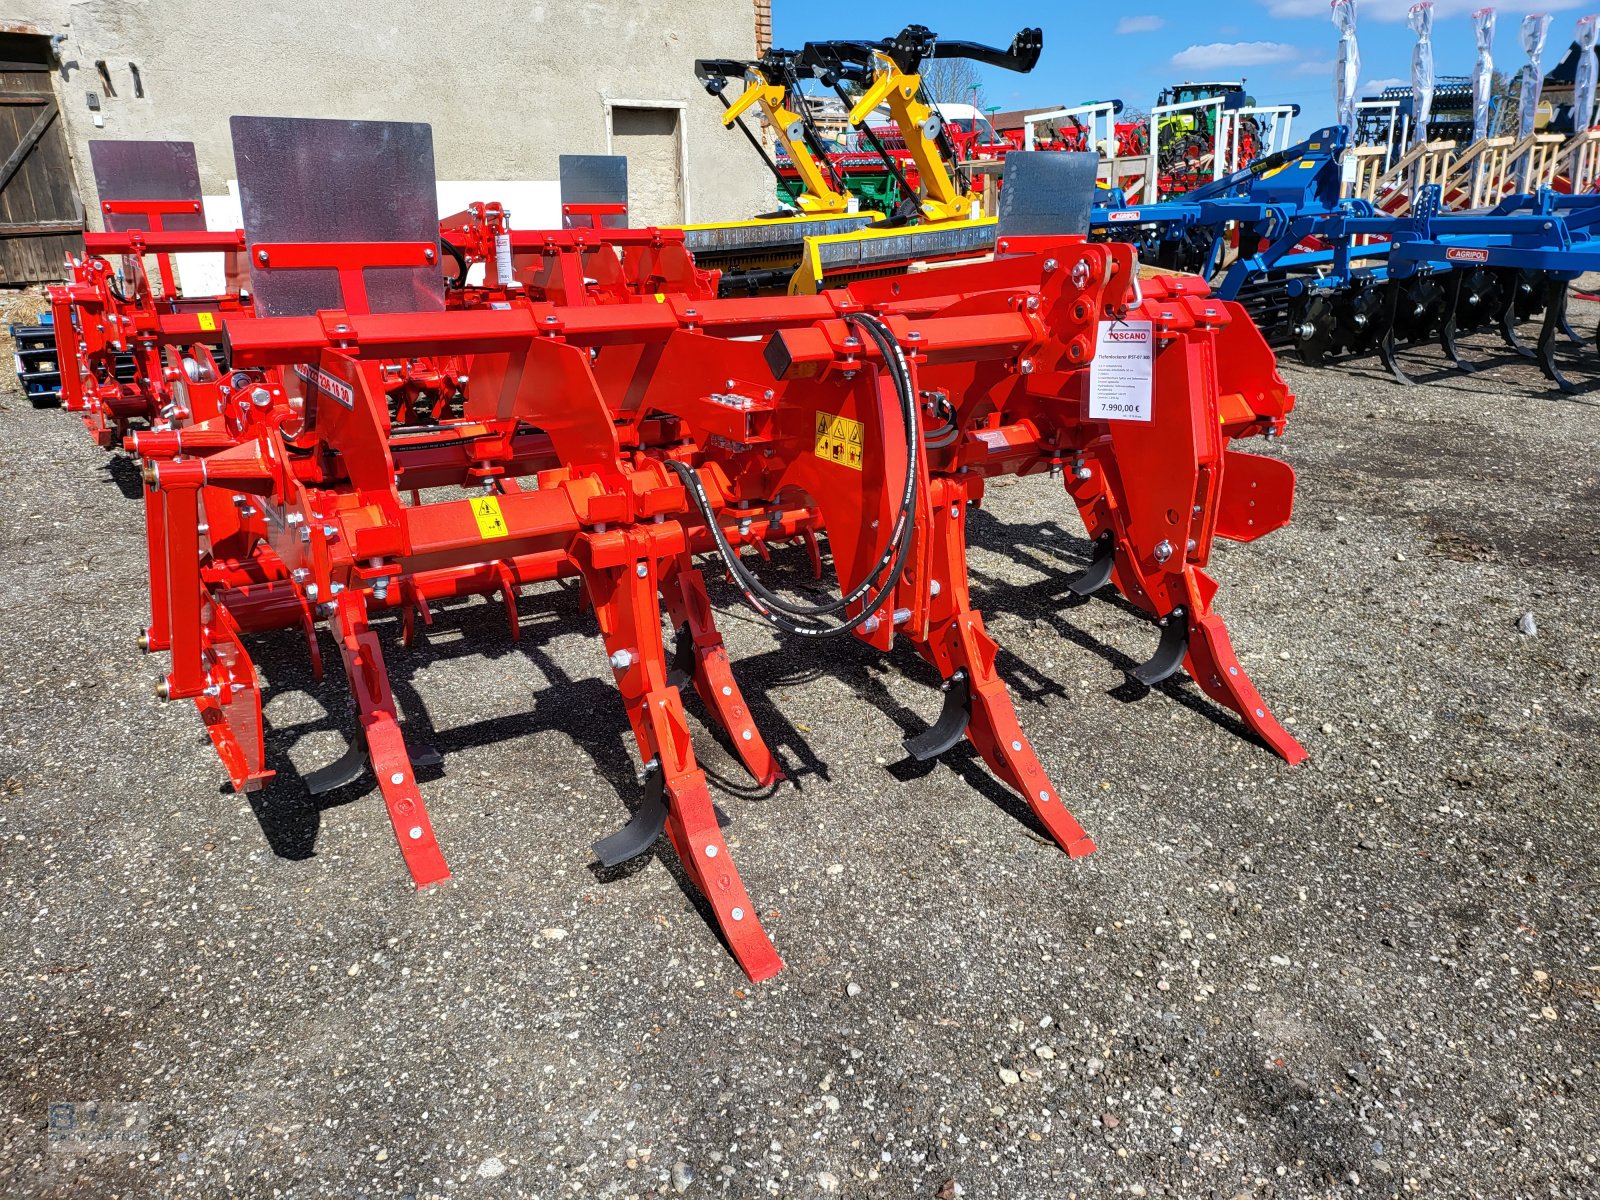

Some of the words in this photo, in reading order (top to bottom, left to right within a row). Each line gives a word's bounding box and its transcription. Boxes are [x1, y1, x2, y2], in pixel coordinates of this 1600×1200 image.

[1455, 250, 1486, 259] AGRIPOL
[1108, 332, 1146, 340] TOSCANO
[1101, 403, 1134, 412] 7.990,00
